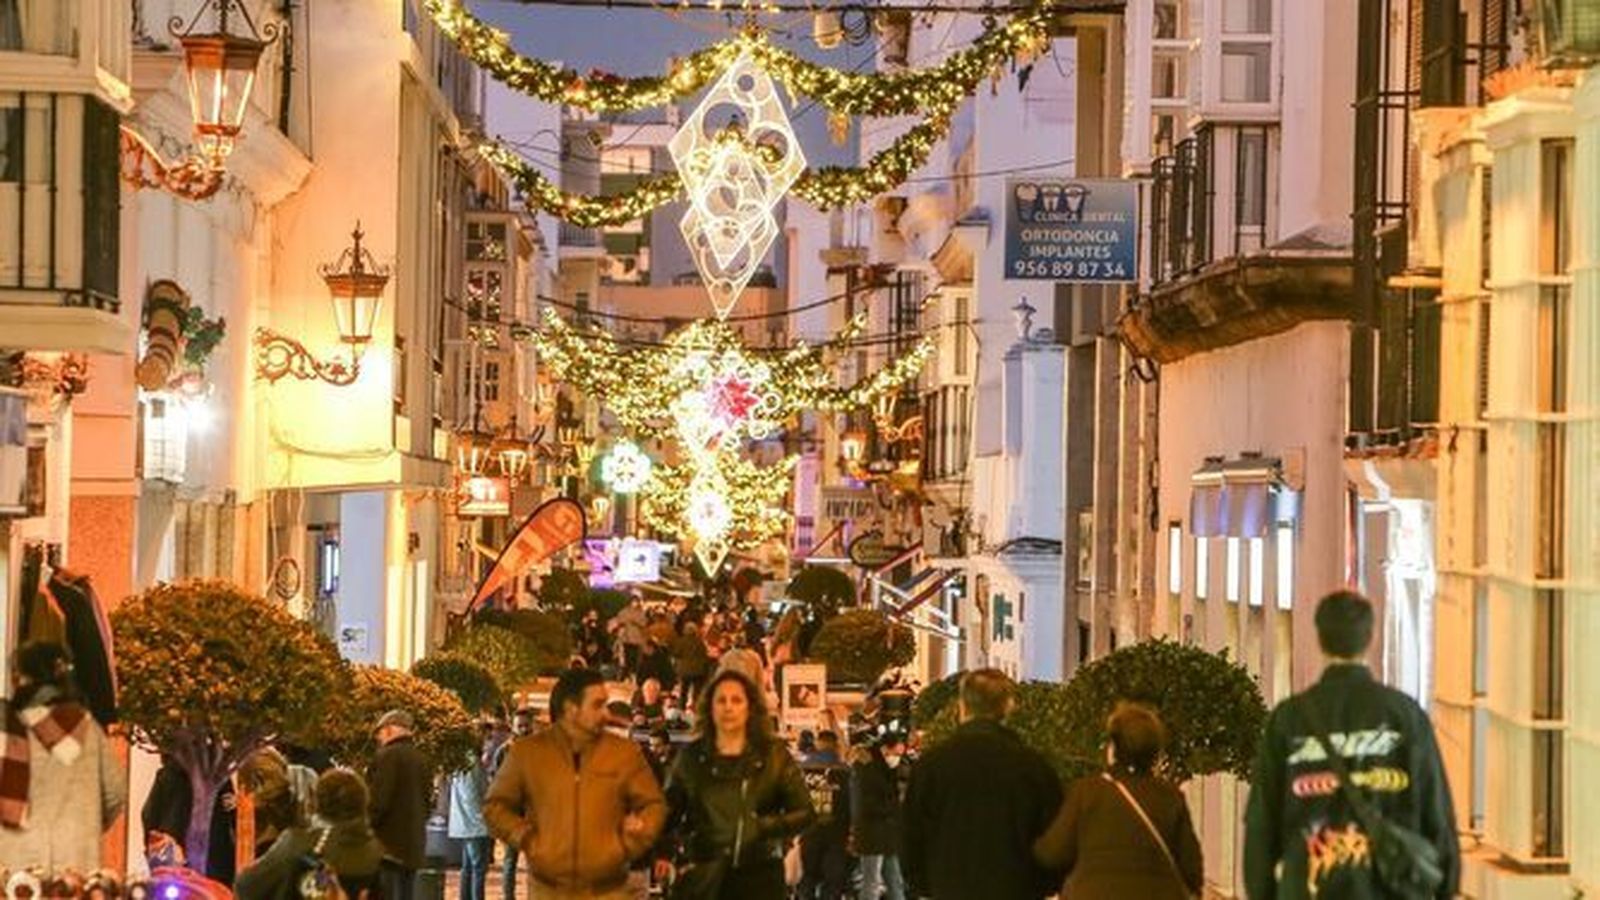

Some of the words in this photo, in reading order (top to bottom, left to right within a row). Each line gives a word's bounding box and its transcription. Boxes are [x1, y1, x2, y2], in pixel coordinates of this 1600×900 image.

[1082, 212, 1125, 223] DENTAL
[1021, 229, 1119, 243] ORTODONCIA
[1029, 244, 1111, 259] IMPLANTES
[1014, 260, 1048, 276] 956
[1052, 261, 1073, 276] 89
[1077, 261, 1099, 277] 87
[1103, 262, 1125, 278] 34
